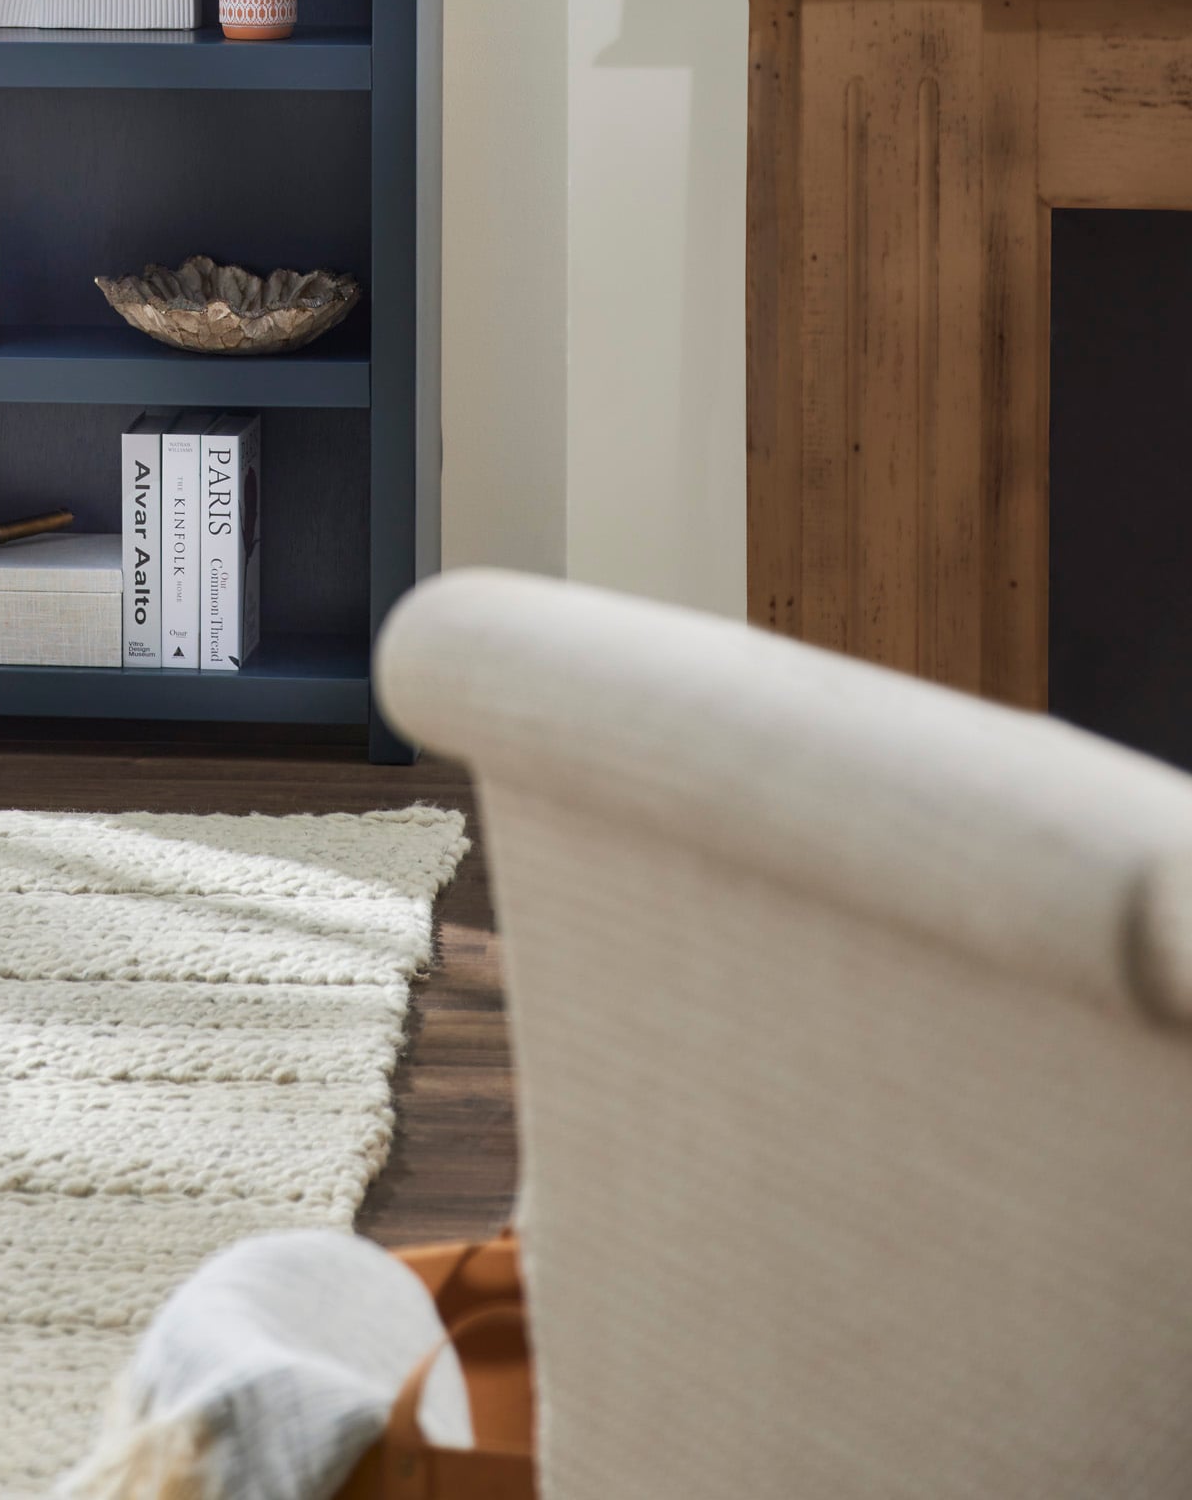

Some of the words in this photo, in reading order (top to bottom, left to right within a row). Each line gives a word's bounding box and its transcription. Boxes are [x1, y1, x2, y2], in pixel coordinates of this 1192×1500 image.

[134, 460, 151, 539] Alvar
[208, 448, 232, 536] PARIS
[174, 498, 186, 576] KINFOLK
[134, 547, 151, 625] Aalto
[210, 558, 223, 616] Common
[220, 572, 229, 589] Our
[210, 617, 224, 662] Thread
